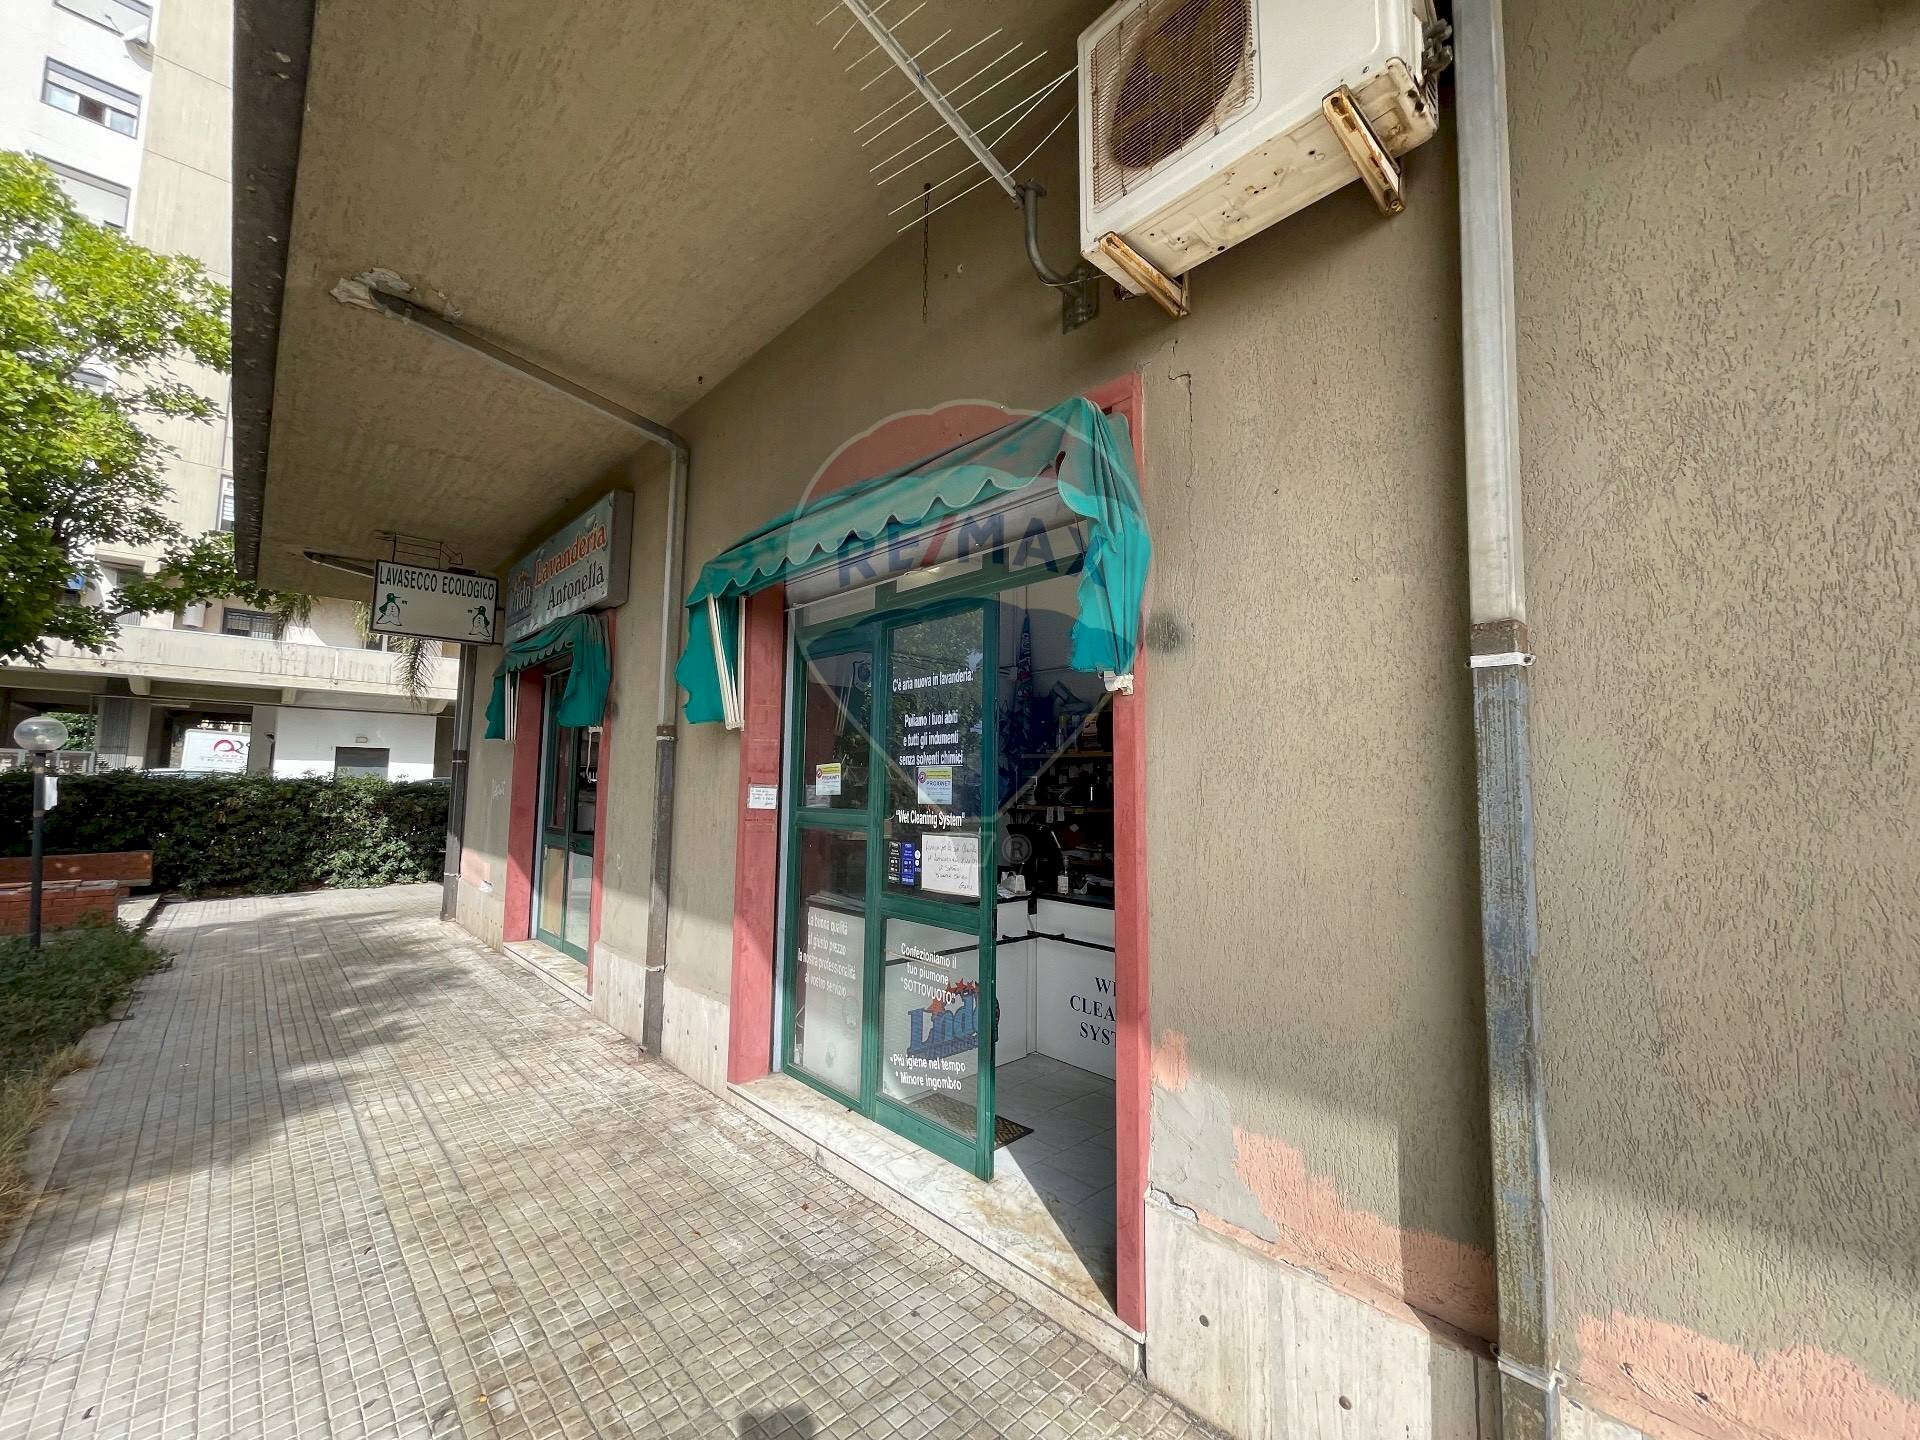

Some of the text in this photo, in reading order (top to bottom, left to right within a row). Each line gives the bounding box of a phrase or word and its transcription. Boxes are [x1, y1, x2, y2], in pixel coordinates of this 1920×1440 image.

[534, 521, 607, 587] Lavanderia
[380, 566, 495, 600] LAVASECCO ECOLOGICO
[547, 561, 604, 610] Antonella
[902, 677, 913, 690] aria
[914, 677, 931, 689] nuova
[933, 673, 939, 686] in
[905, 713, 927, 727] Puliamo
[932, 711, 943, 725] tuoi
[945, 710, 959, 724] abiti
[908, 733, 919, 746] tutti
[920, 732, 928, 749] gli
[929, 730, 959, 745] indumenti
[899, 750, 963, 766] senza solventi chimici
[813, 933, 829, 950] giusto
[803, 952, 818, 967] nostra
[901, 942, 957, 969] Confezioniamo il
[907, 962, 949, 985] tuo piumone
[810, 974, 825, 991] vostro
[826, 981, 847, 997] servizio
[905, 1056, 927, 1070] igiene
[929, 1058, 940, 1070] nel
[941, 1058, 966, 1076] tempo
[900, 1071, 962, 1091] Minore ingombro
